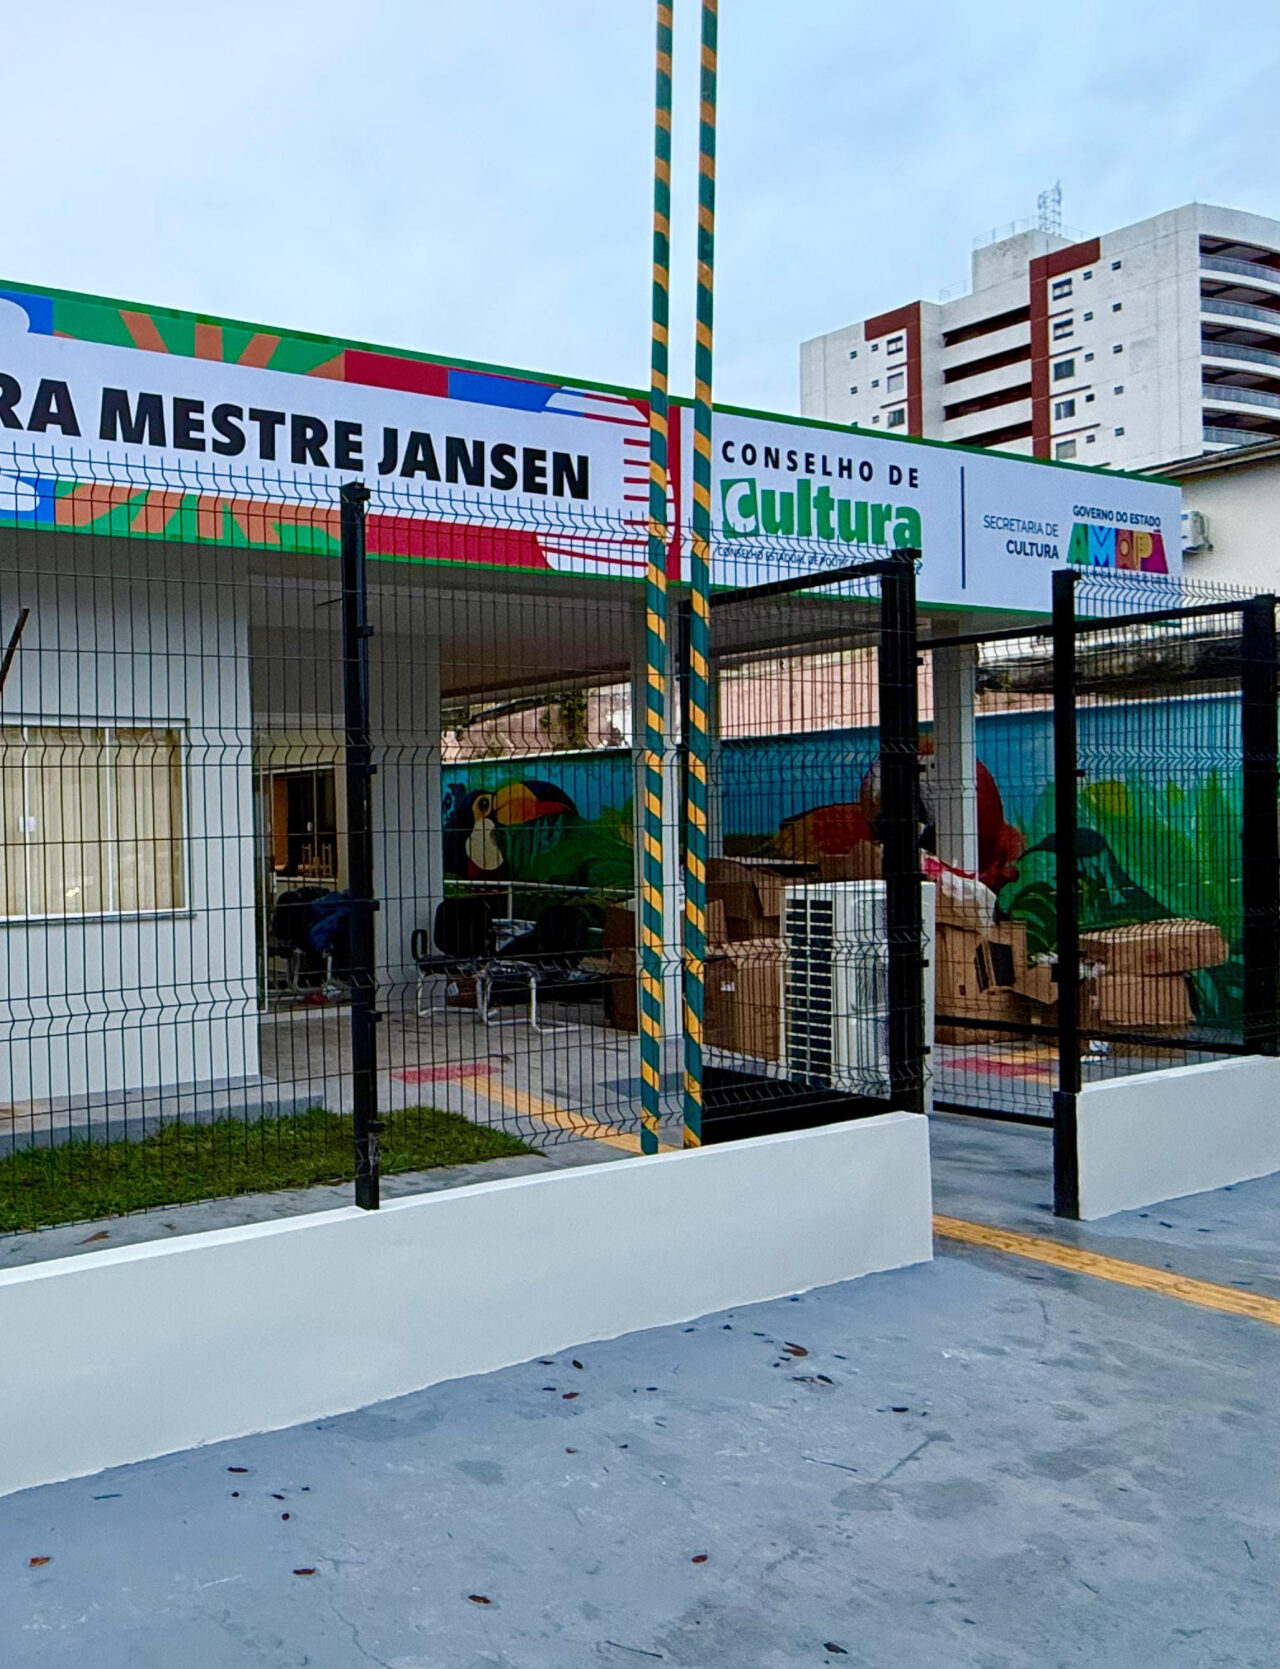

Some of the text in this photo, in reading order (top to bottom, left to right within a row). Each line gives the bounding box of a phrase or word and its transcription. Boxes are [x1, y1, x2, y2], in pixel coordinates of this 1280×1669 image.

[98, 387, 365, 472] MESTRE
[377, 426, 590, 500] JANSEN
[722, 440, 919, 489] CONSELHO DE
[720, 477, 922, 549] Cultura
[983, 514, 1059, 537] SECRETARIA DE
[1073, 505, 1161, 527] GOVERNO DO ESTADO
[1006, 539, 1059, 559] CULTURA
